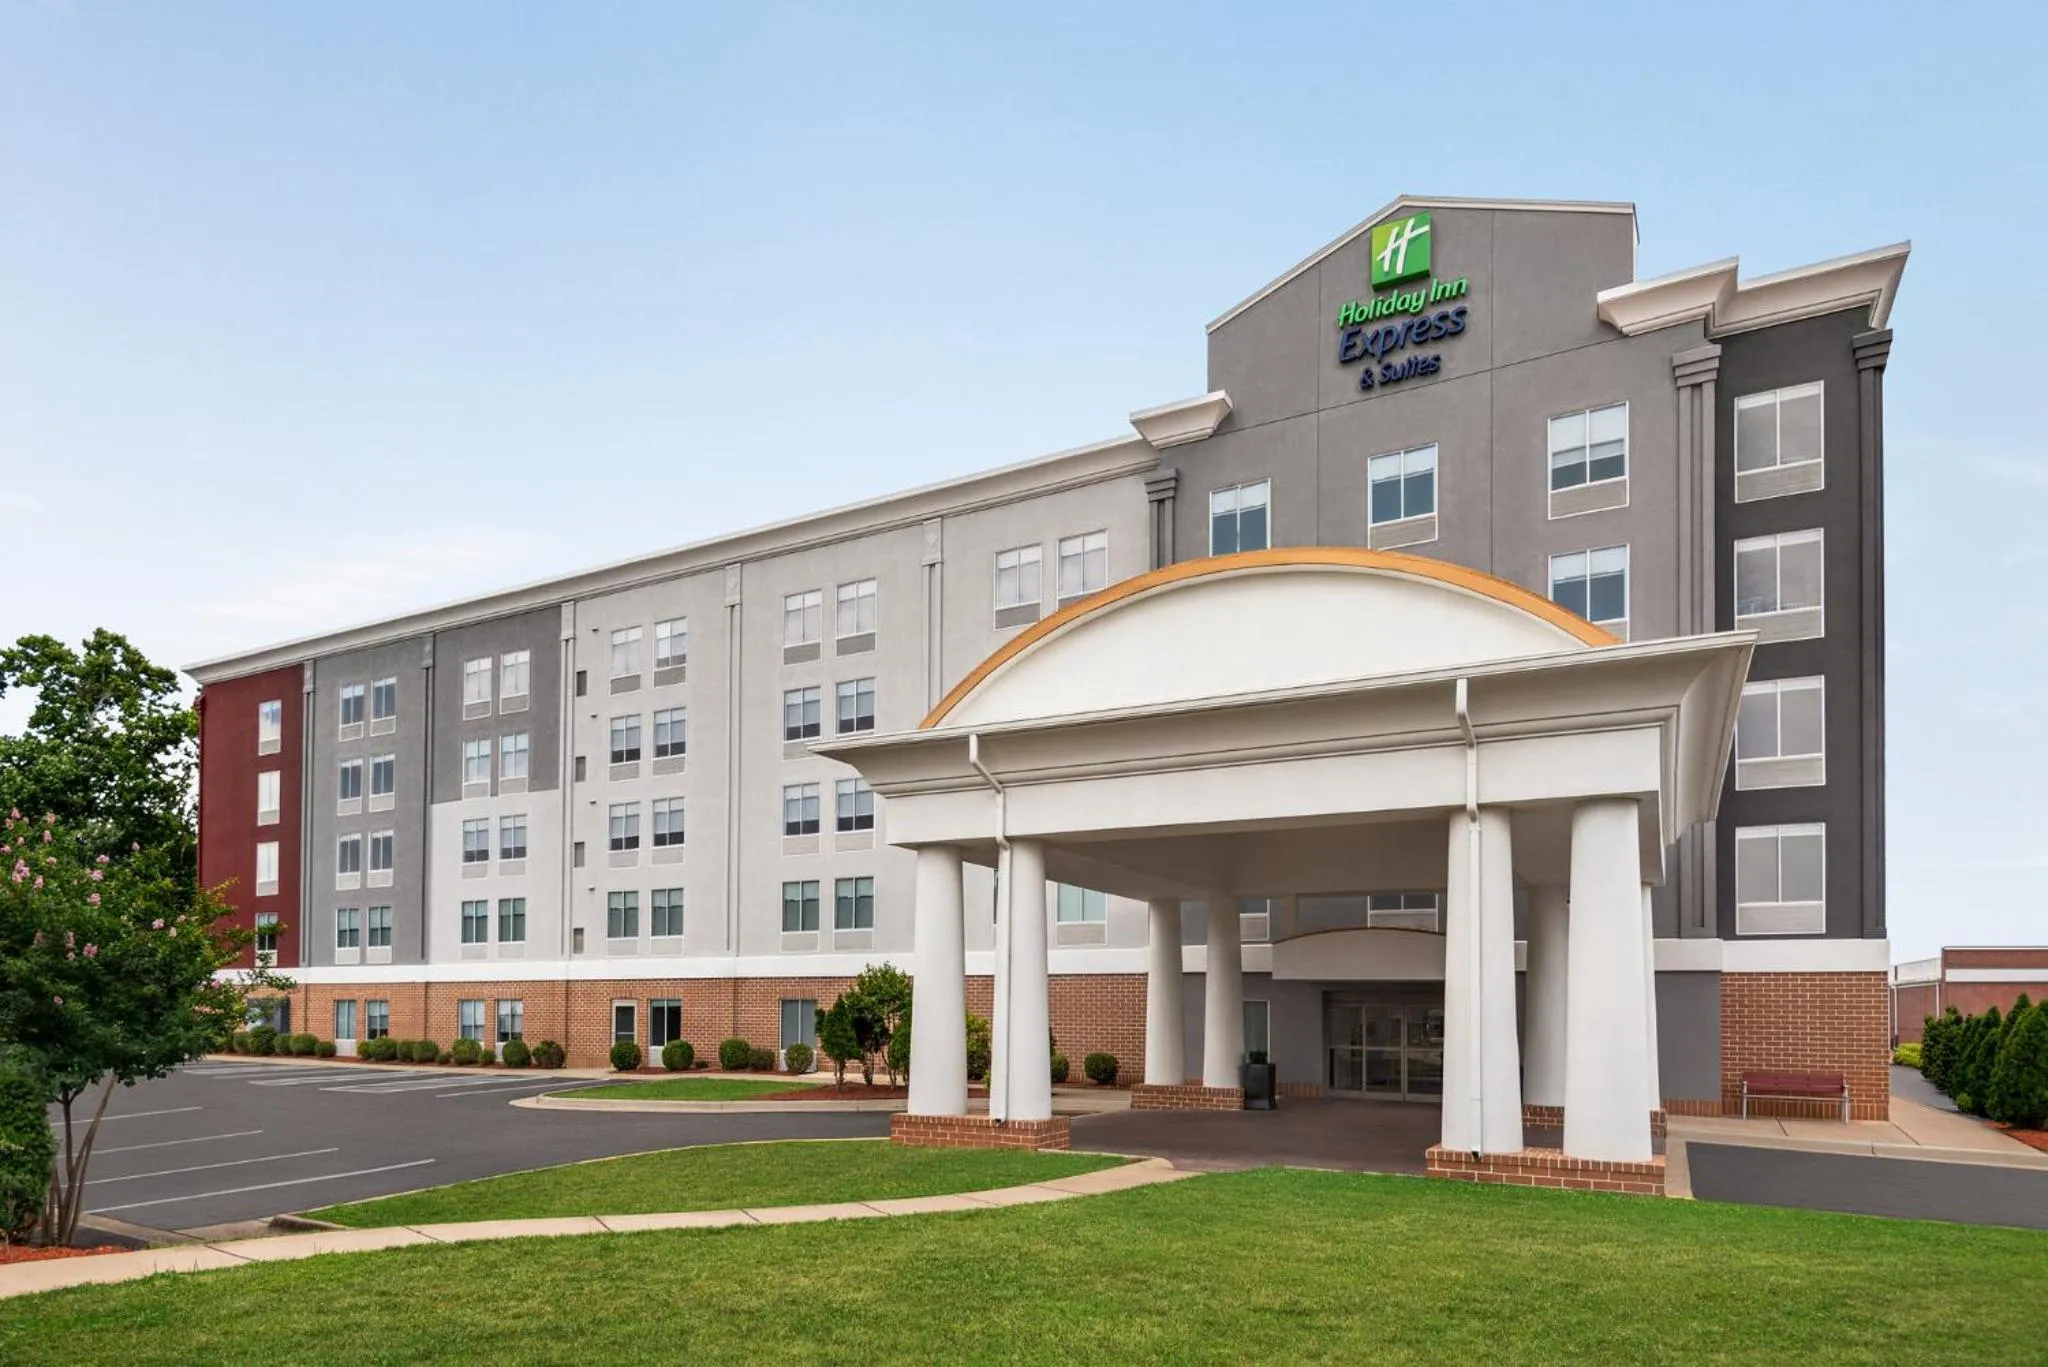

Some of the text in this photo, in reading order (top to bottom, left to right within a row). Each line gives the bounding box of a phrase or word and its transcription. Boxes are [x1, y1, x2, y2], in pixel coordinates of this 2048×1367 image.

[1376, 218, 1430, 274] H
[1338, 277, 1468, 328] Holiday Inn
[1339, 306, 1468, 364] Express
[1360, 354, 1441, 391] & Suites
